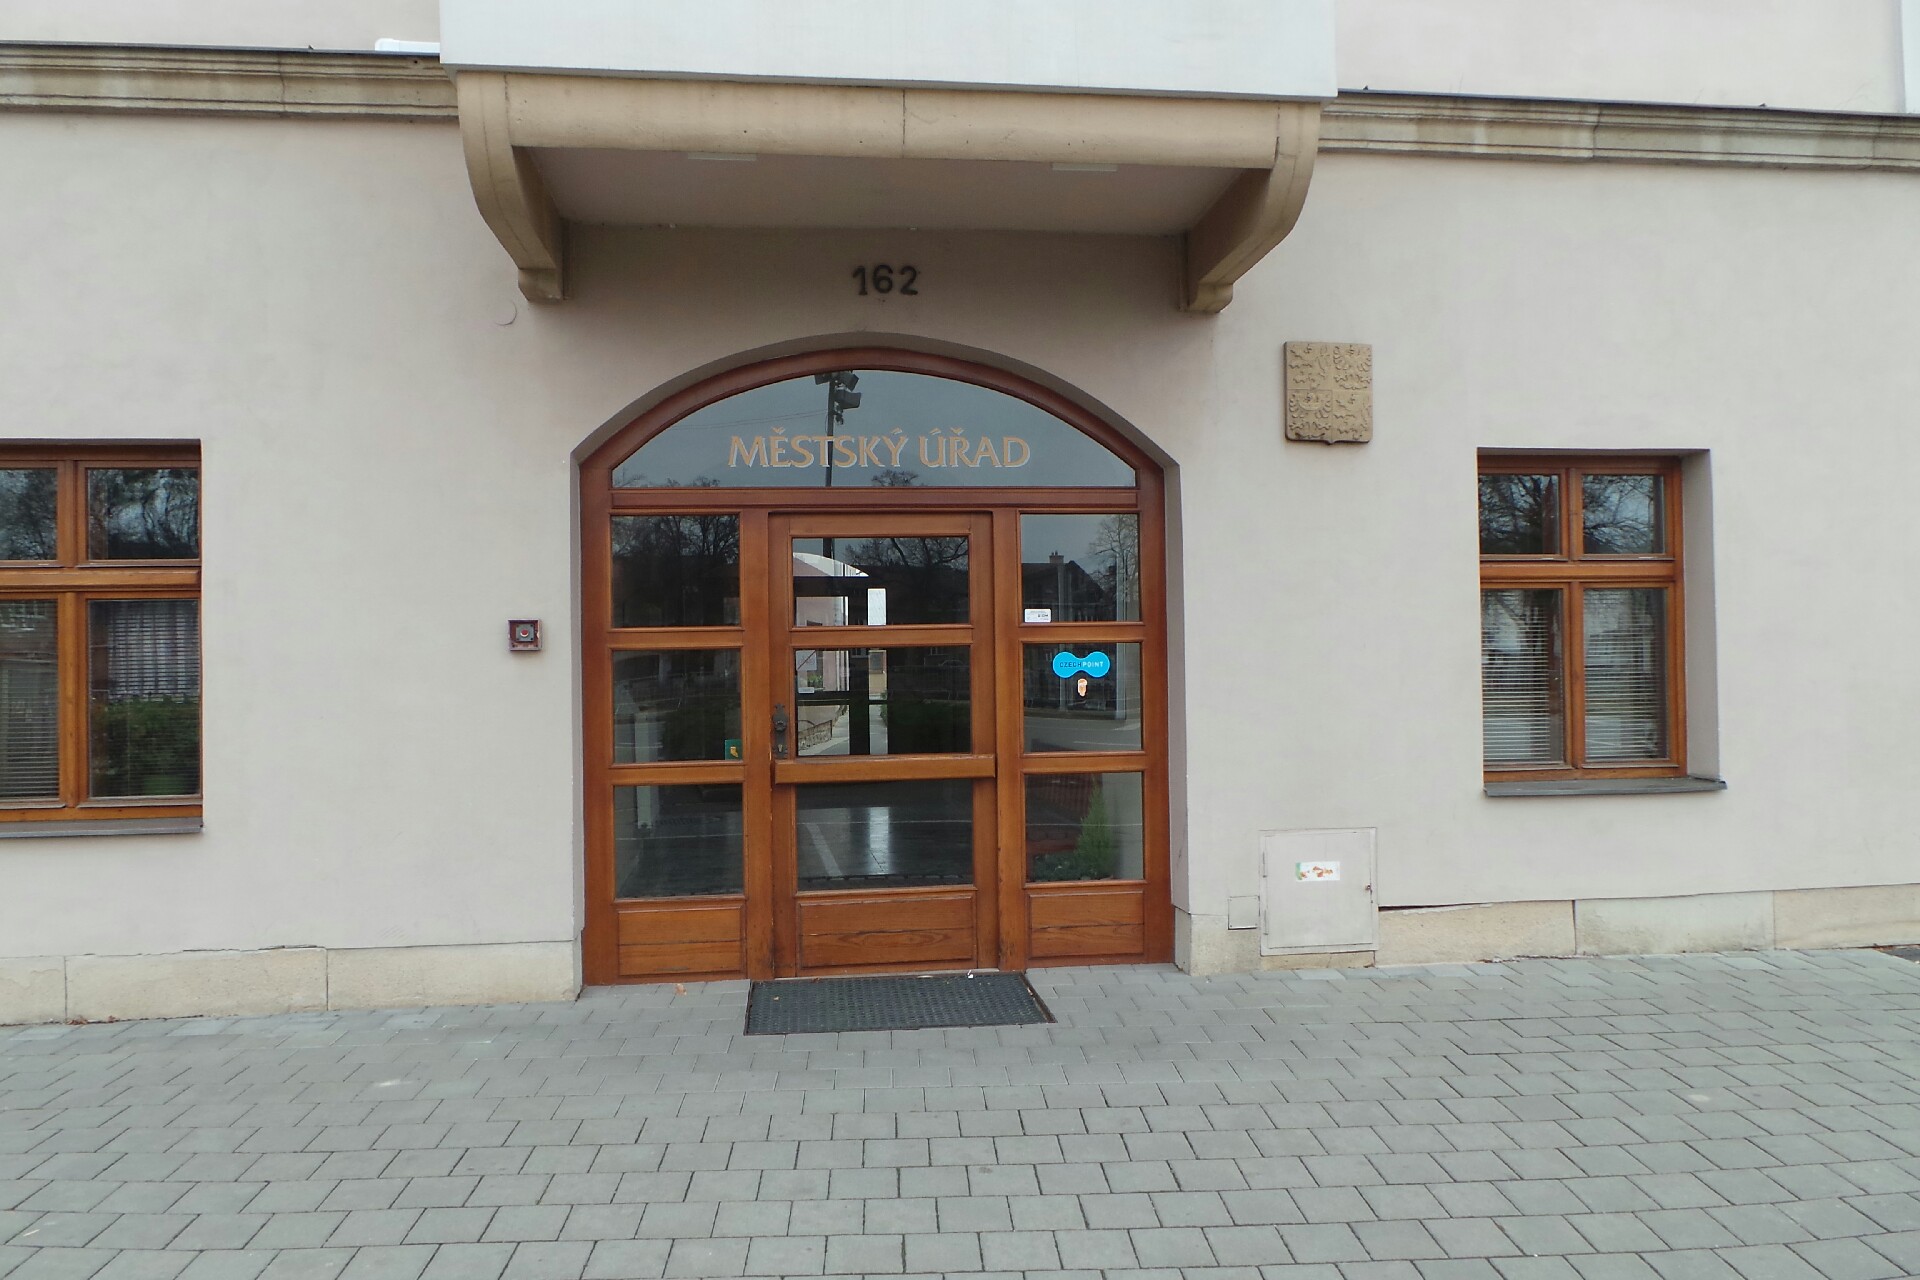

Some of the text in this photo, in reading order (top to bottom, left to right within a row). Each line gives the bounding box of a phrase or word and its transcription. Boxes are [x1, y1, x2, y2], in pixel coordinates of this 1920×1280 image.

[852, 264, 919, 296] 162
[728, 426, 1031, 468] MĚSTSKÝ ÚŘAD
